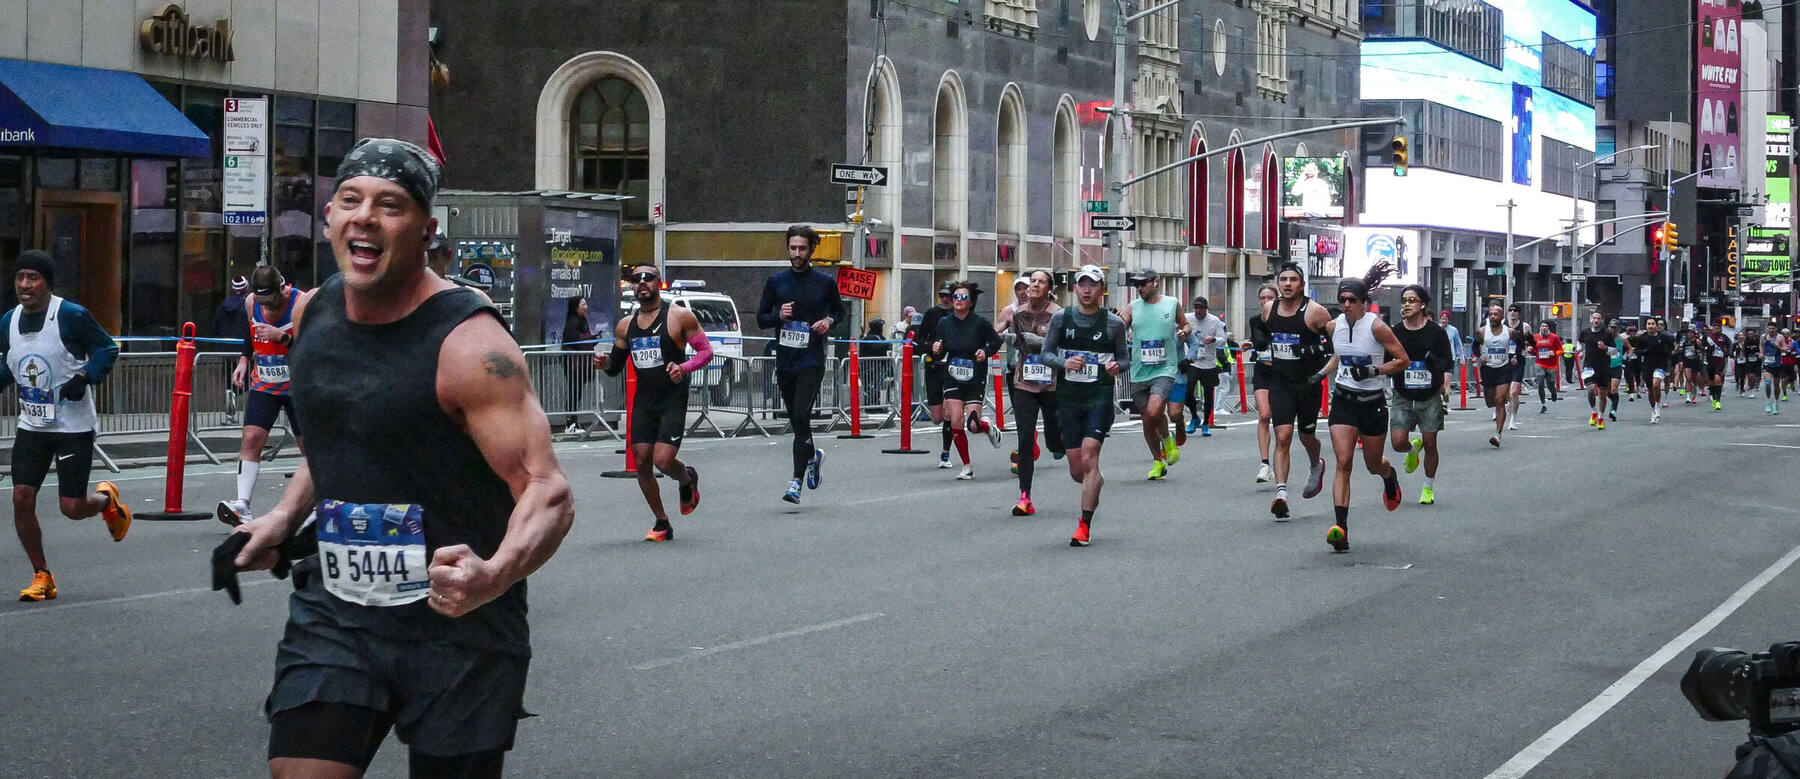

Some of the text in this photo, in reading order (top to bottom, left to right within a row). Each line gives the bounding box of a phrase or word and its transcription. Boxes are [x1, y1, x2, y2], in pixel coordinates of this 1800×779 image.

[141, 4, 234, 61] citibank
[1701, 64, 1738, 84] WHITE FOX
[228, 100, 236, 112] 3
[228, 156, 235, 167] 6
[840, 170, 880, 181] ONE WAY
[1115, 220, 1129, 228] WAY
[551, 227, 571, 247] Target
[551, 264, 580, 280] emails on
[840, 270, 873, 285] RAISE
[583, 284, 592, 299] TV
[840, 282, 870, 296] PLOW
[787, 331, 805, 342] 5709
[639, 349, 658, 361] 2049
[265, 366, 287, 377] 6688
[1024, 365, 1029, 374] B
[1342, 367, 1349, 377] A
[1405, 371, 1411, 379] B
[325, 549, 410, 583] B 5444
